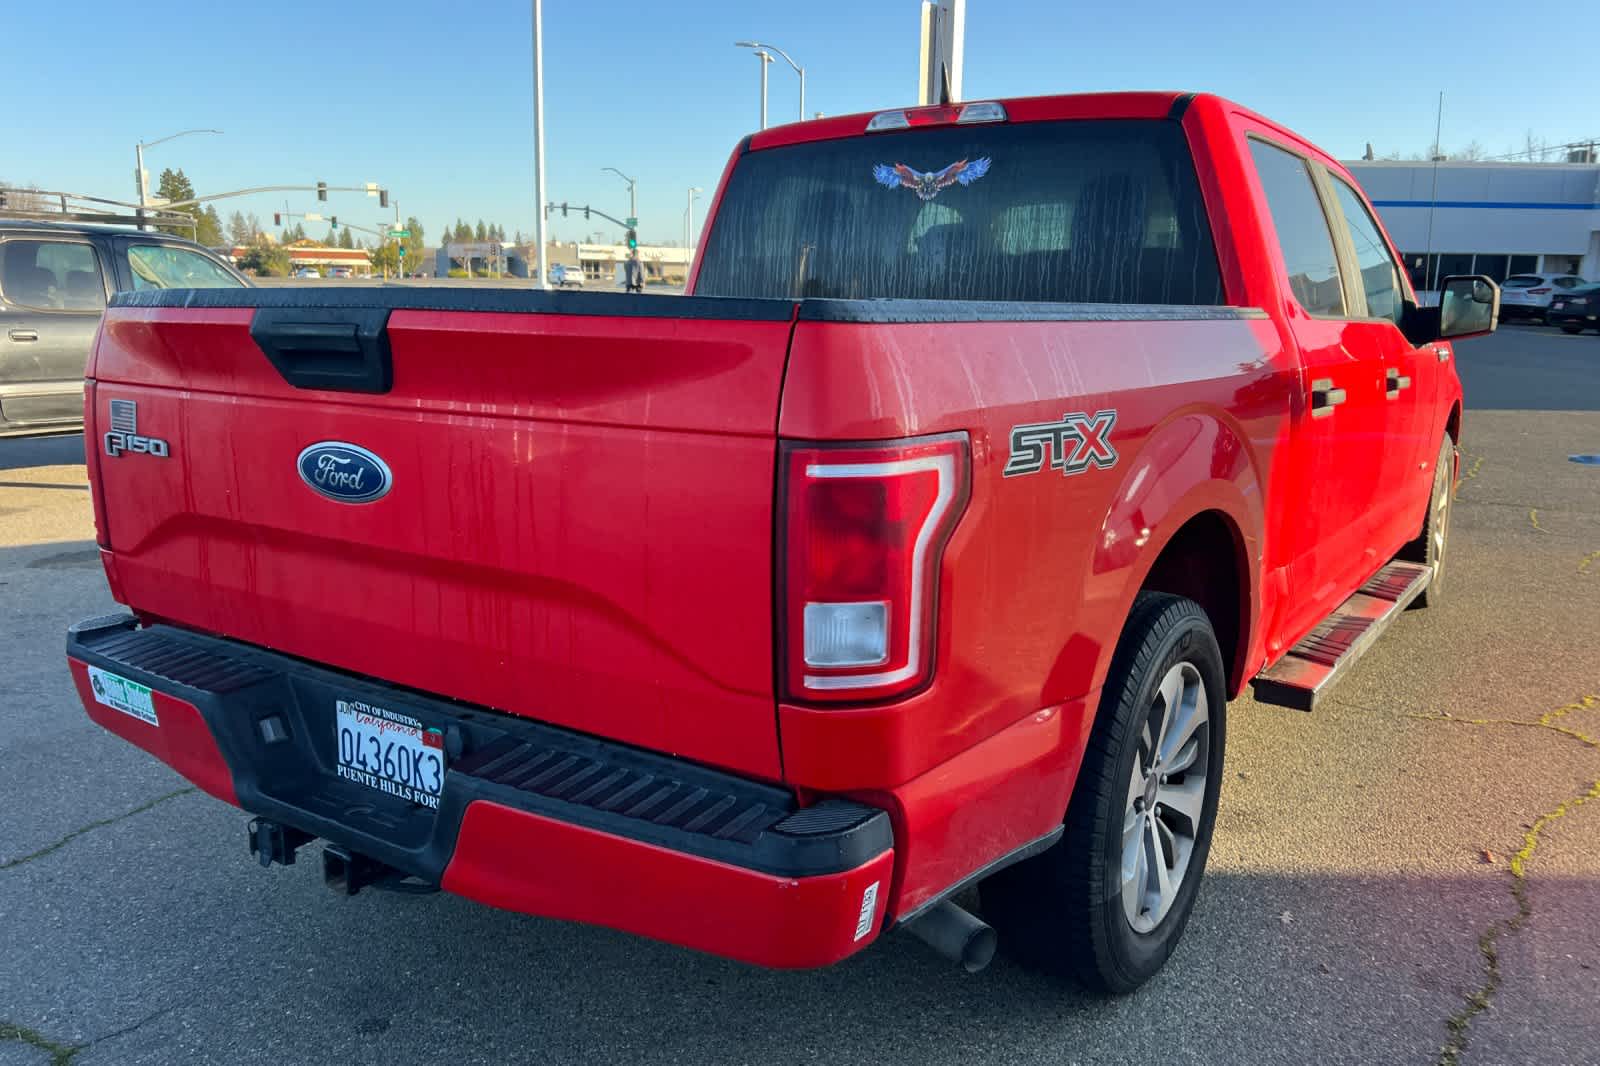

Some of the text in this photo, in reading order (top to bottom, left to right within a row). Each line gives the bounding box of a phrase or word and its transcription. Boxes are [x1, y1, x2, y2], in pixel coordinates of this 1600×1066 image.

[1002, 409, 1119, 478] STX
[314, 454, 364, 490] Ford
[354, 701, 417, 726] CITY OF INDUSTRY
[341, 727, 441, 795] 04360K3
[337, 764, 378, 788] PUENTE
[379, 778, 412, 800] HILLS
